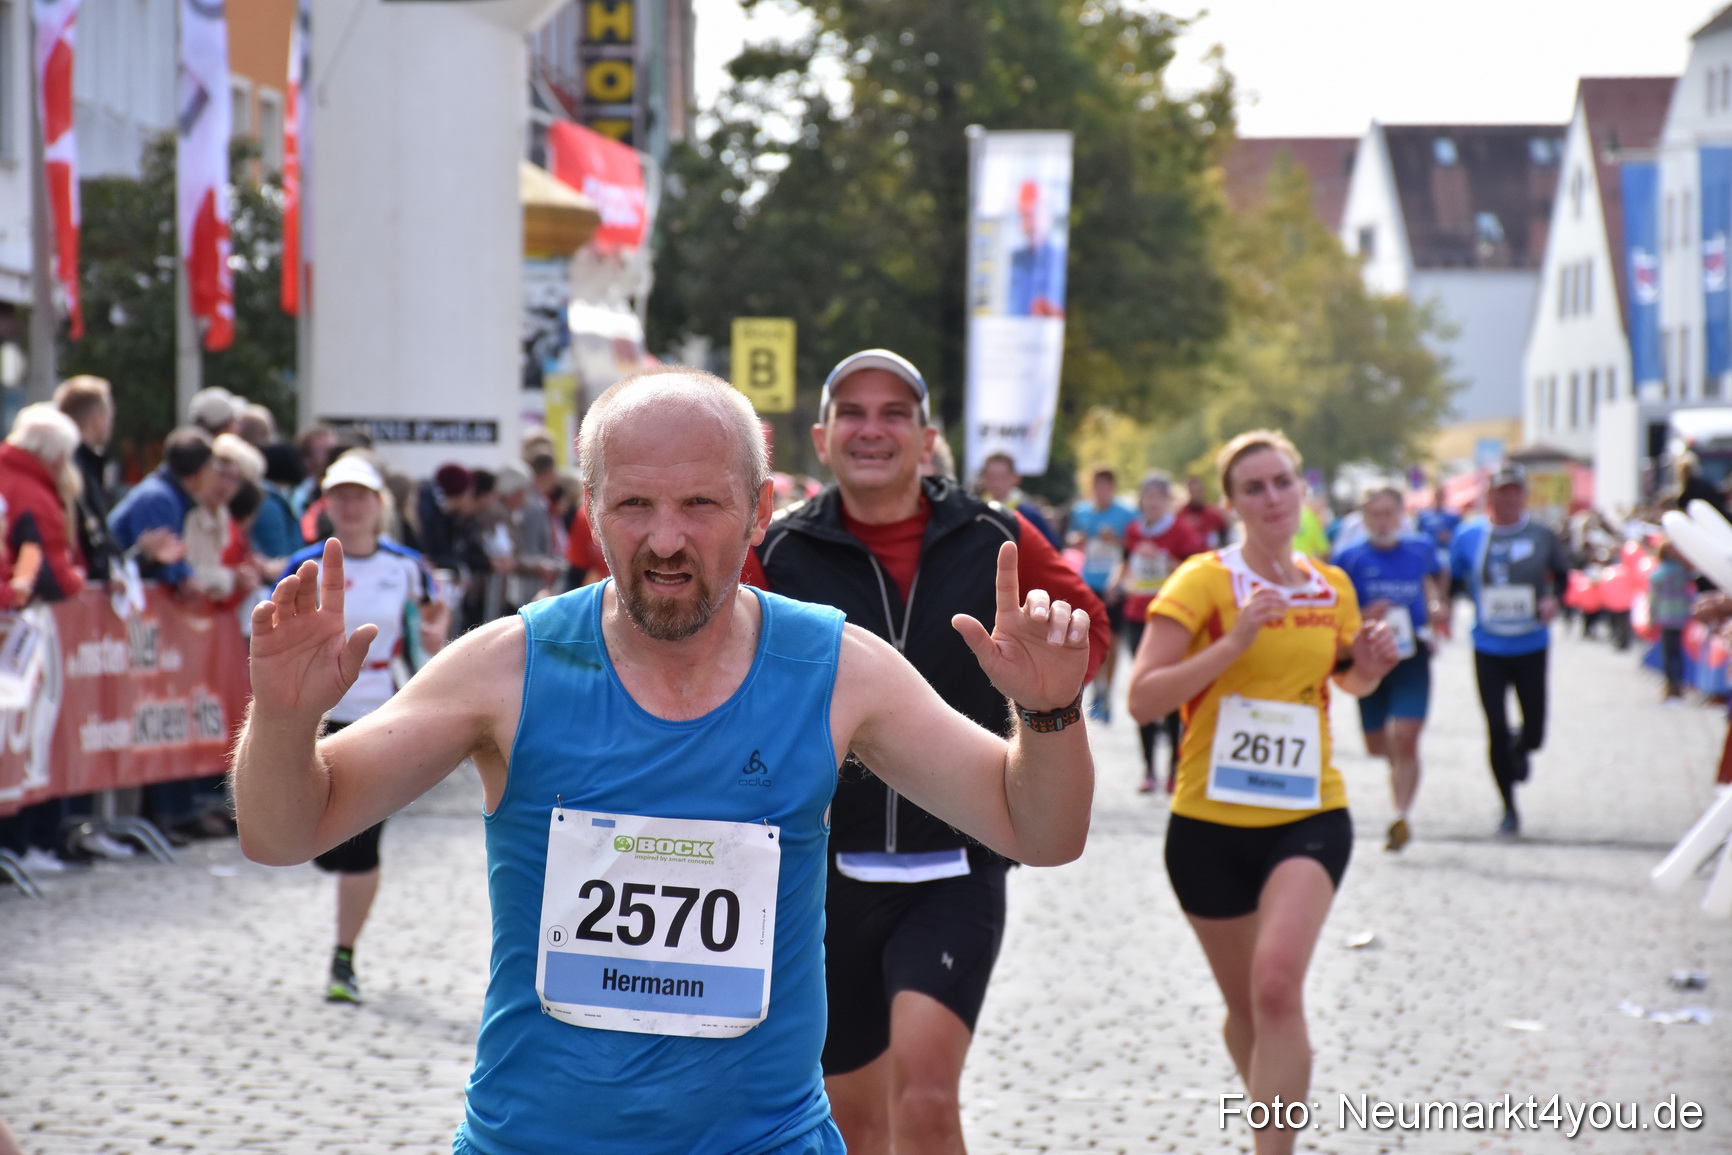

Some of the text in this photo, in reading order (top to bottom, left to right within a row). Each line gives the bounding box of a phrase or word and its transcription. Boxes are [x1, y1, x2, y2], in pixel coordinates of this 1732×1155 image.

[748, 347, 778, 388] B
[1231, 730, 1306, 769] 2617
[738, 776, 772, 787] odlo
[634, 854, 659, 863] inspired
[687, 858, 715, 866] concepts
[636, 837, 714, 858] BOCK
[576, 878, 741, 952] 2570
[552, 930, 562, 943] D
[602, 967, 705, 998] Hermann
